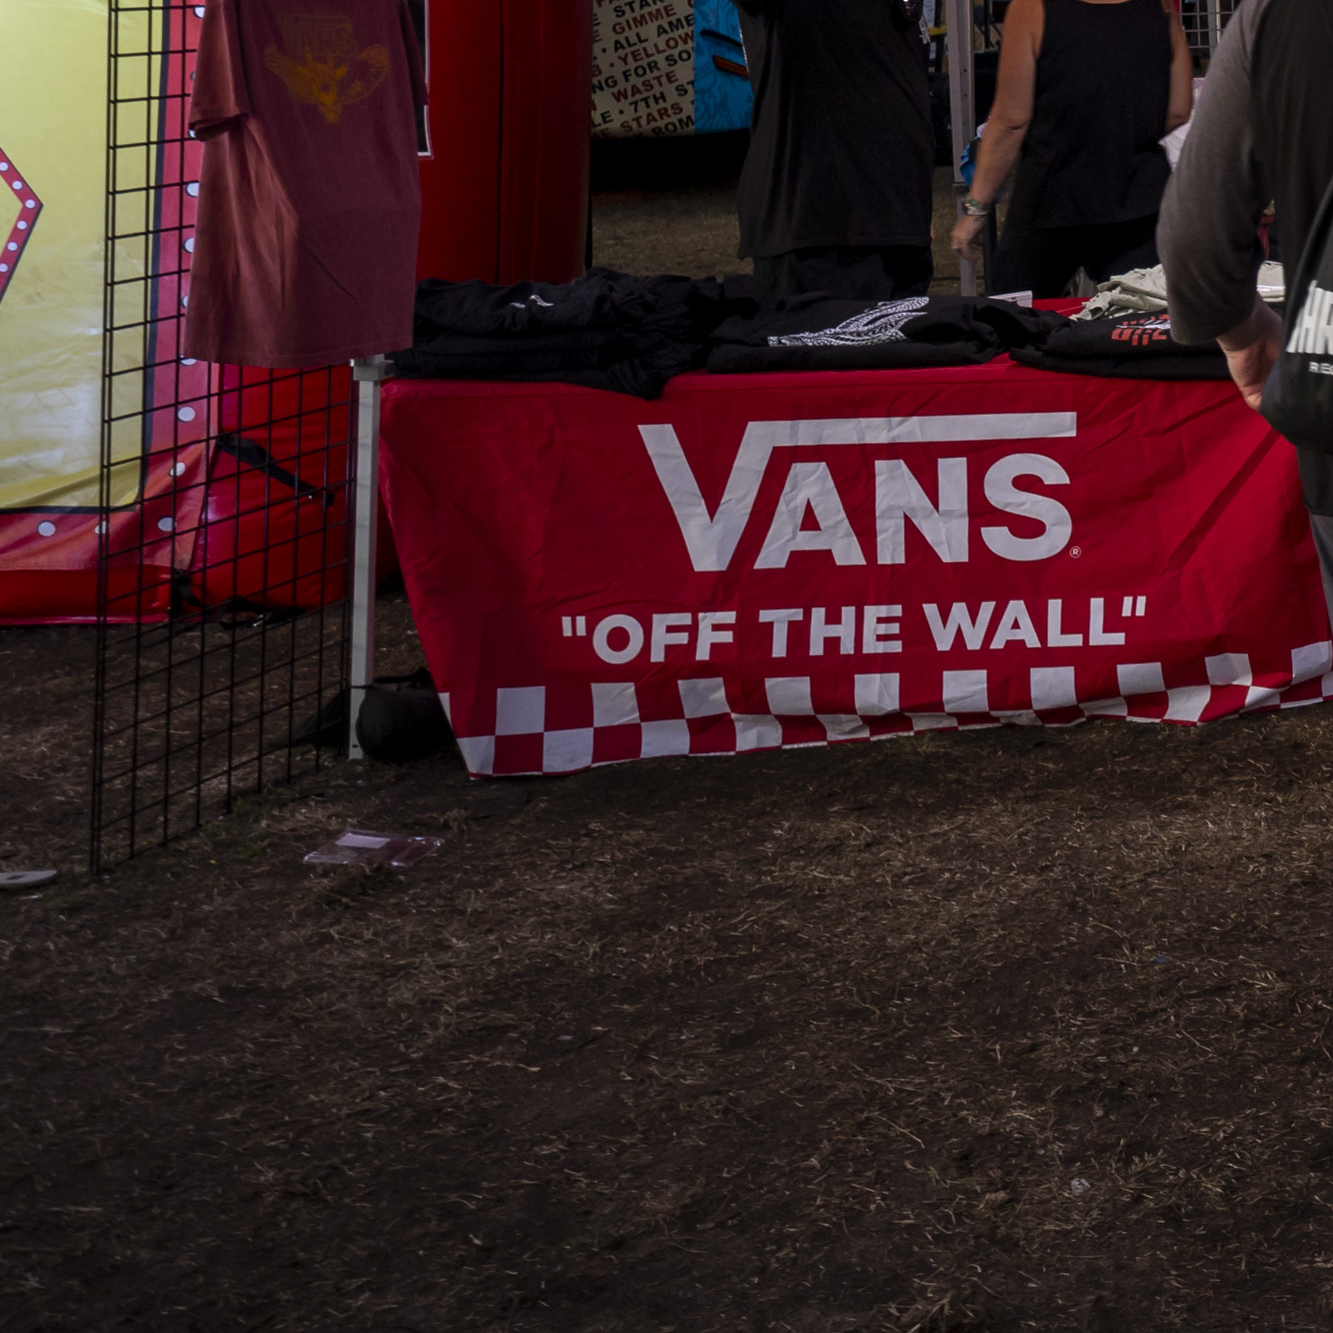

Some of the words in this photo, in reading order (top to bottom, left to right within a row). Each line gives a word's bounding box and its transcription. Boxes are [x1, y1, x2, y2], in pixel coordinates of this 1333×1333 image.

[612, 4, 677, 35] GIMME
[614, 32, 649, 53] ALL
[611, 70, 679, 103] WASTE
[622, 60, 661, 83] FOR
[621, 102, 684, 133] STARS
[629, 91, 667, 113] 7TH
[638, 412, 1077, 572] VANS
[562, 612, 734, 664] "OFF
[760, 605, 903, 658] THE
[922, 596, 1147, 650] WALL"
